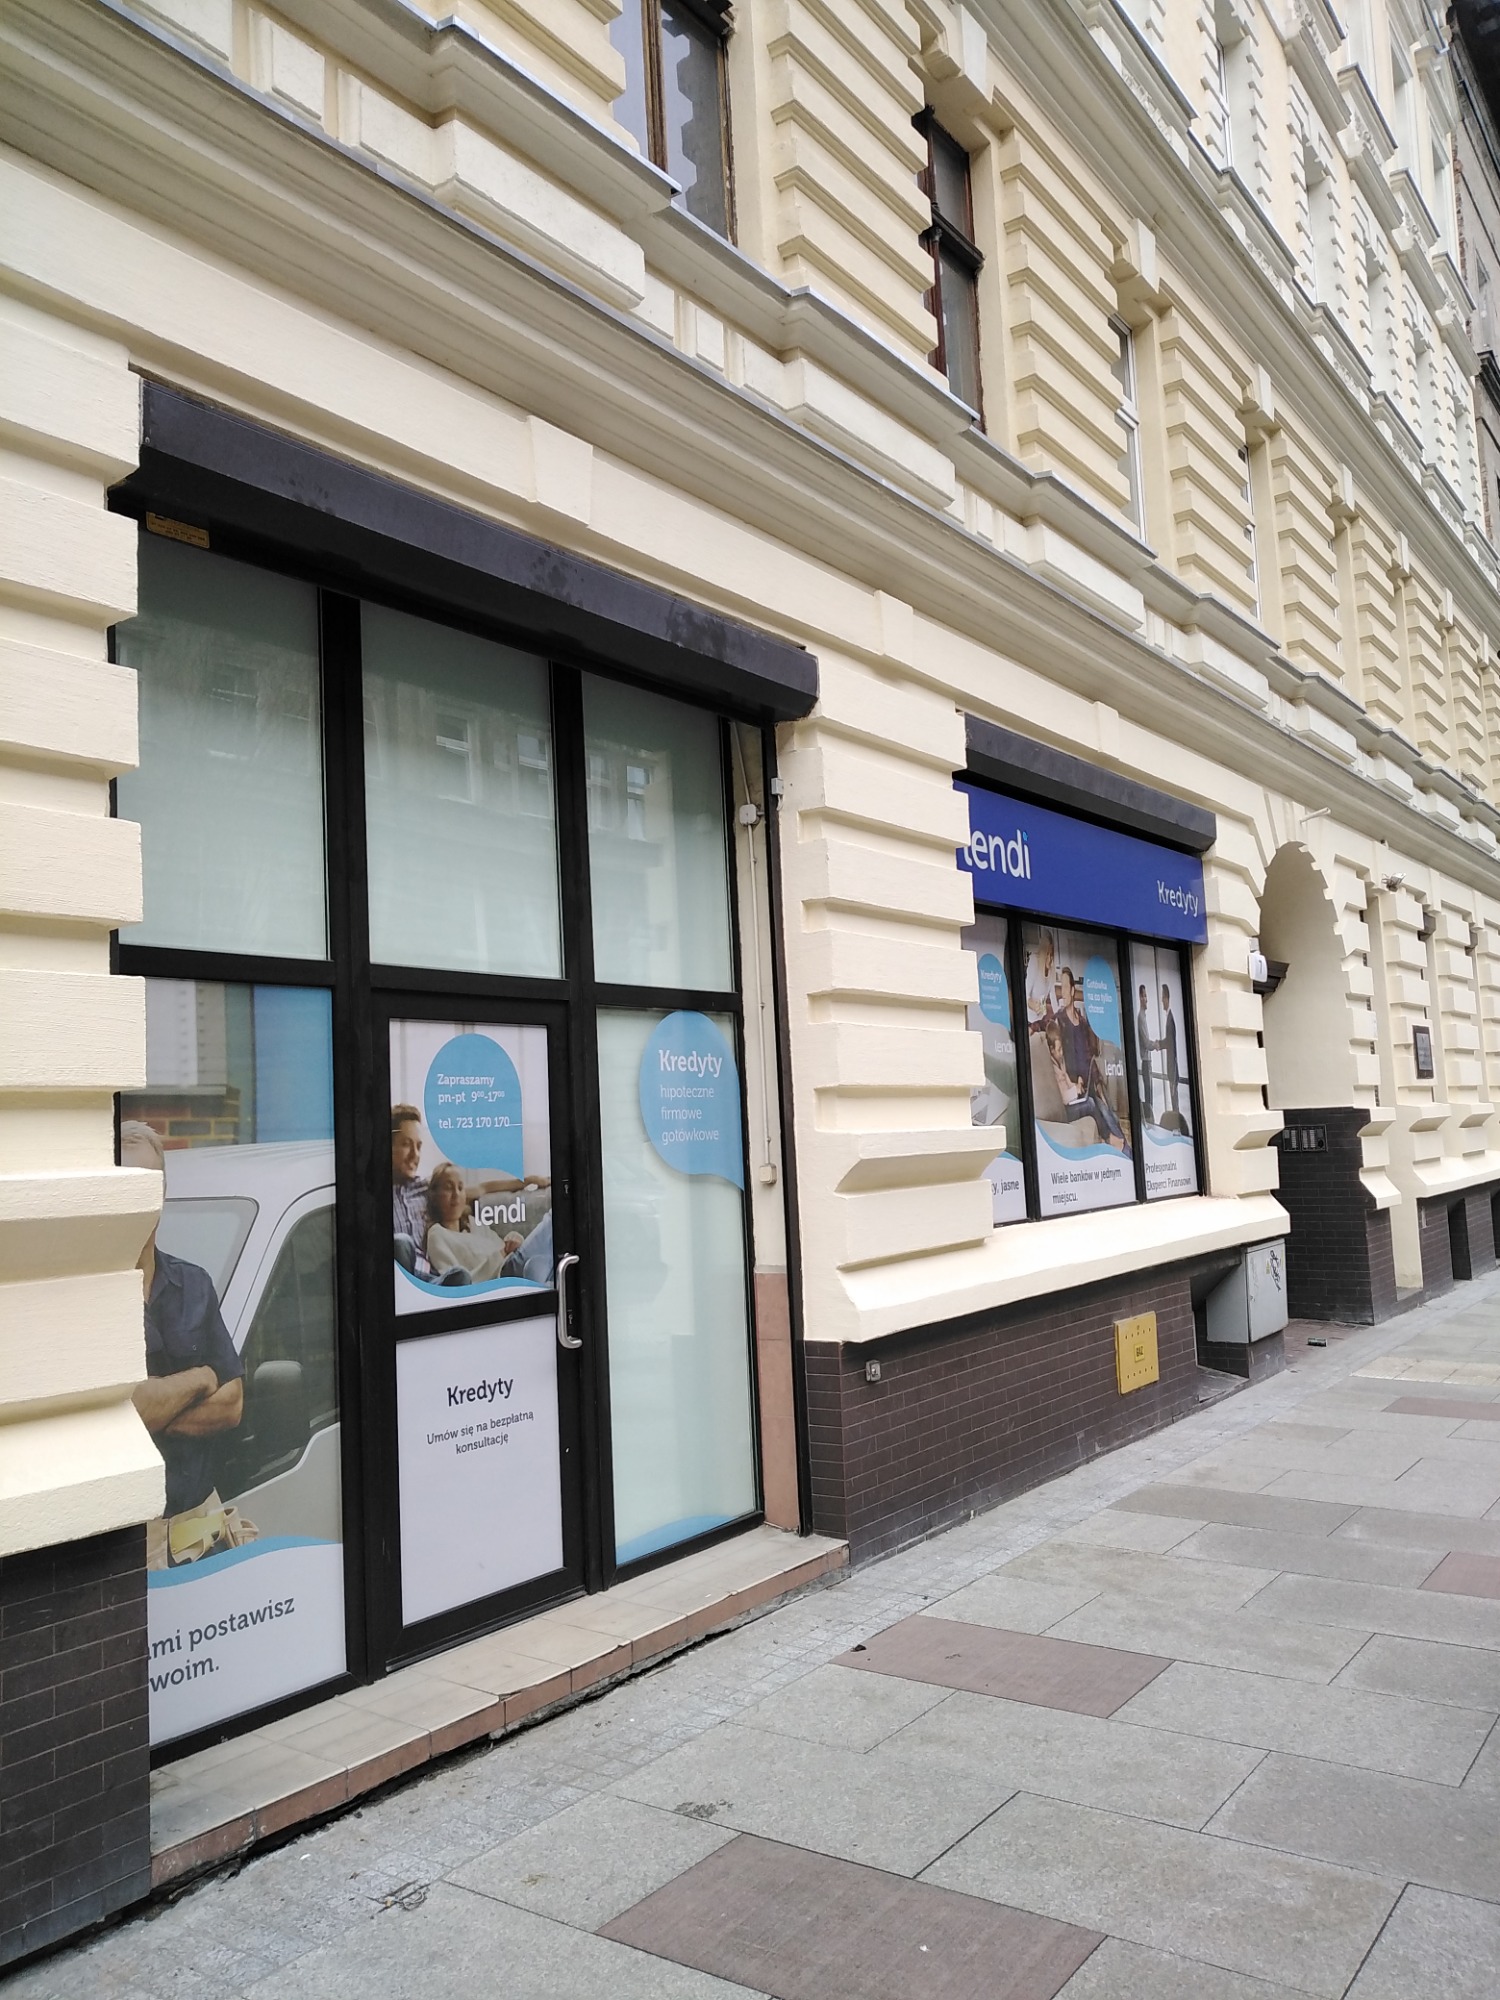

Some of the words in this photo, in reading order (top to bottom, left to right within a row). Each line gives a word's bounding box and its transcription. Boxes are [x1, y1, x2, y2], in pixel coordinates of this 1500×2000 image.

[1156, 879, 1198, 918] Kredyty
[658, 1049, 723, 1078] Kredyty
[1104, 1059, 1124, 1077] lendi
[437, 1073, 495, 1087] Zapraszamy
[438, 1091, 466, 1105] pn-pt
[660, 1084, 715, 1101] hipoteczne
[661, 1106, 702, 1120] firmowe
[438, 1117, 454, 1129] tel.
[456, 1117, 474, 1128] 723
[475, 1116, 492, 1128] 170
[494, 1116, 510, 1128] 170
[661, 1127, 720, 1146] gotówkowe
[1050, 1171, 1069, 1185] Wiele
[1069, 1169, 1093, 1183] banków
[1093, 1171, 1100, 1179] w
[1100, 1167, 1122, 1182] jednym
[1000, 1179, 1020, 1195] jasne
[1052, 1190, 1079, 1206] miejscu.
[474, 1196, 527, 1227] lendi
[446, 1377, 514, 1407] Kredyty
[426, 1429, 459, 1445] Umów
[460, 1424, 474, 1437] się
[476, 1422, 488, 1433] na
[490, 1411, 534, 1429] bezpłatną
[455, 1432, 509, 1455] konsultację
[148, 1629, 183, 1661] mi
[188, 1597, 296, 1653] postawisz
[149, 1656, 220, 1693] woim.
